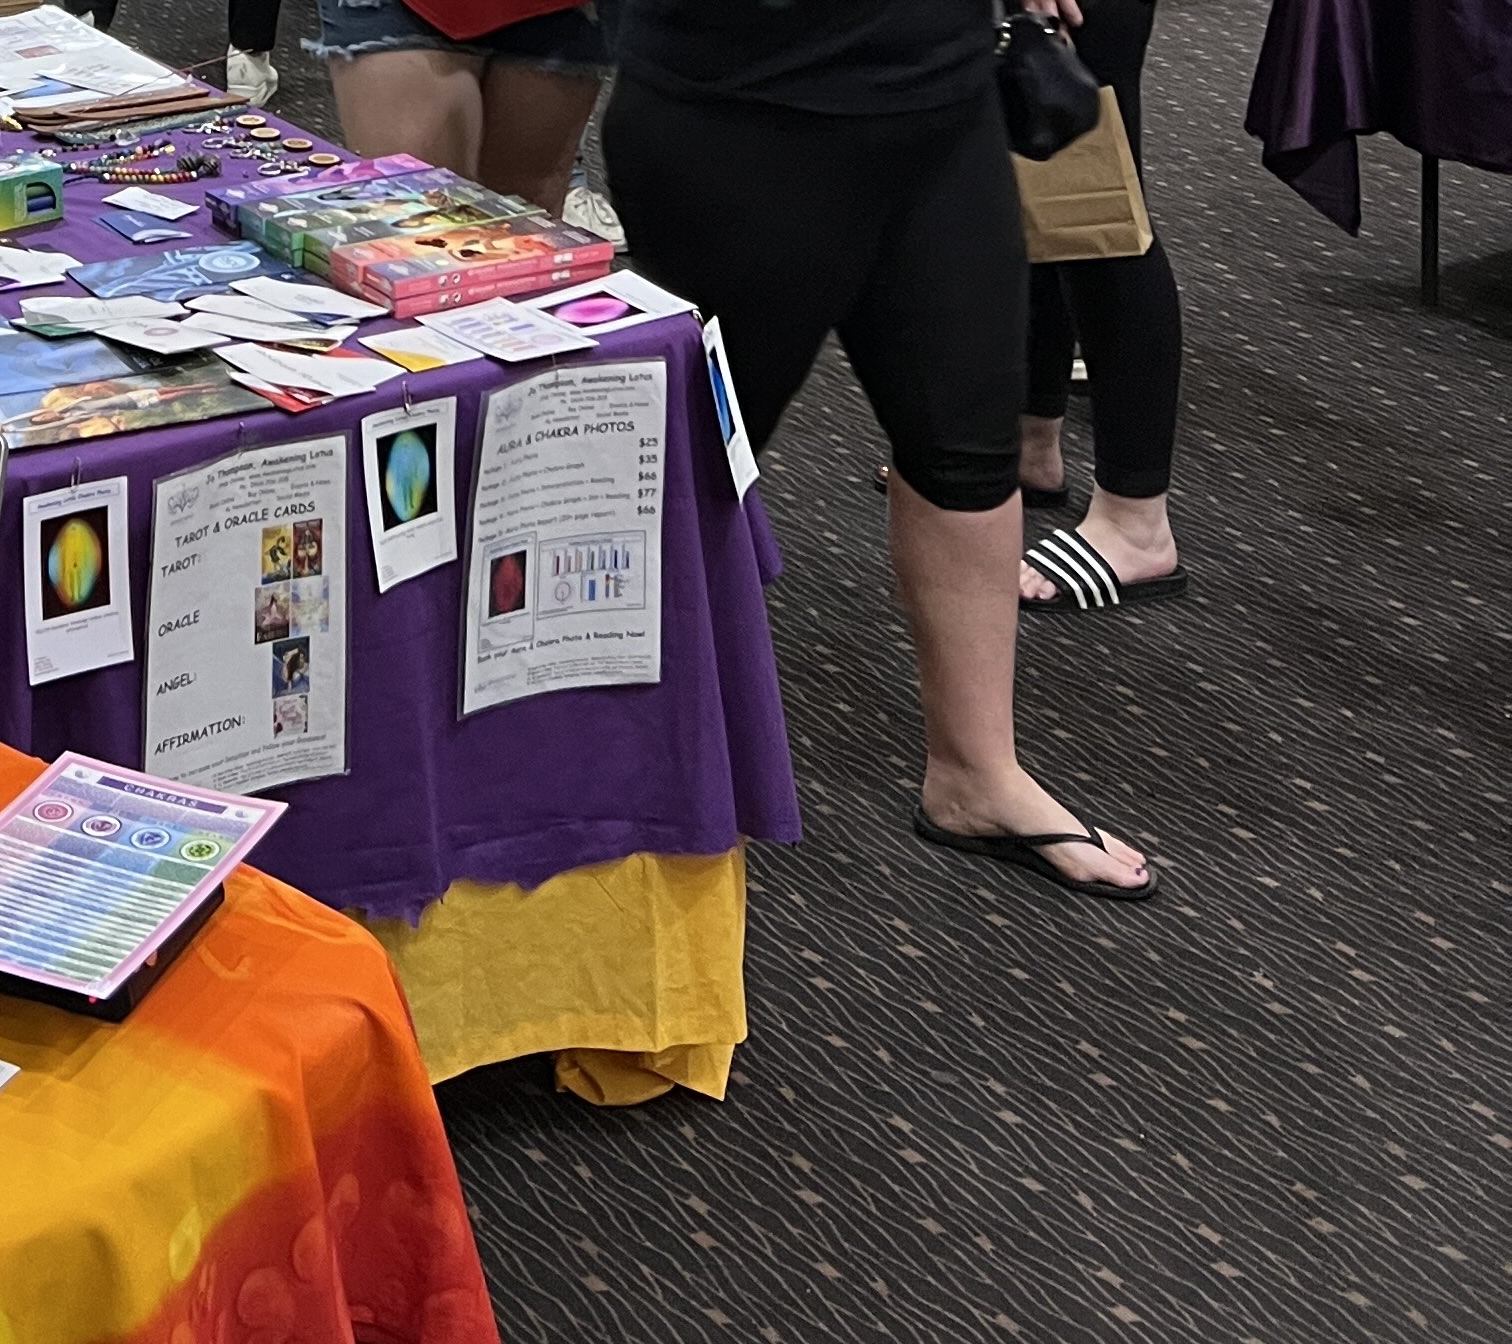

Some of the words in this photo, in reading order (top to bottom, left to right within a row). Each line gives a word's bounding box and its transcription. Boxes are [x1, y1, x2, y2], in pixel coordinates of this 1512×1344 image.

[496, 439, 522, 455] AURA
[535, 427, 578, 443] CHAKRA
[583, 421, 635, 435] PHOTOS
[175, 525, 210, 548] TAROT
[212, 522, 221, 534] &
[224, 507, 269, 530] ORACLE
[273, 500, 316, 518] CARDS
[154, 714, 246, 756] AFFIRMATION:
[123, 783, 198, 807] CHAKRAS
